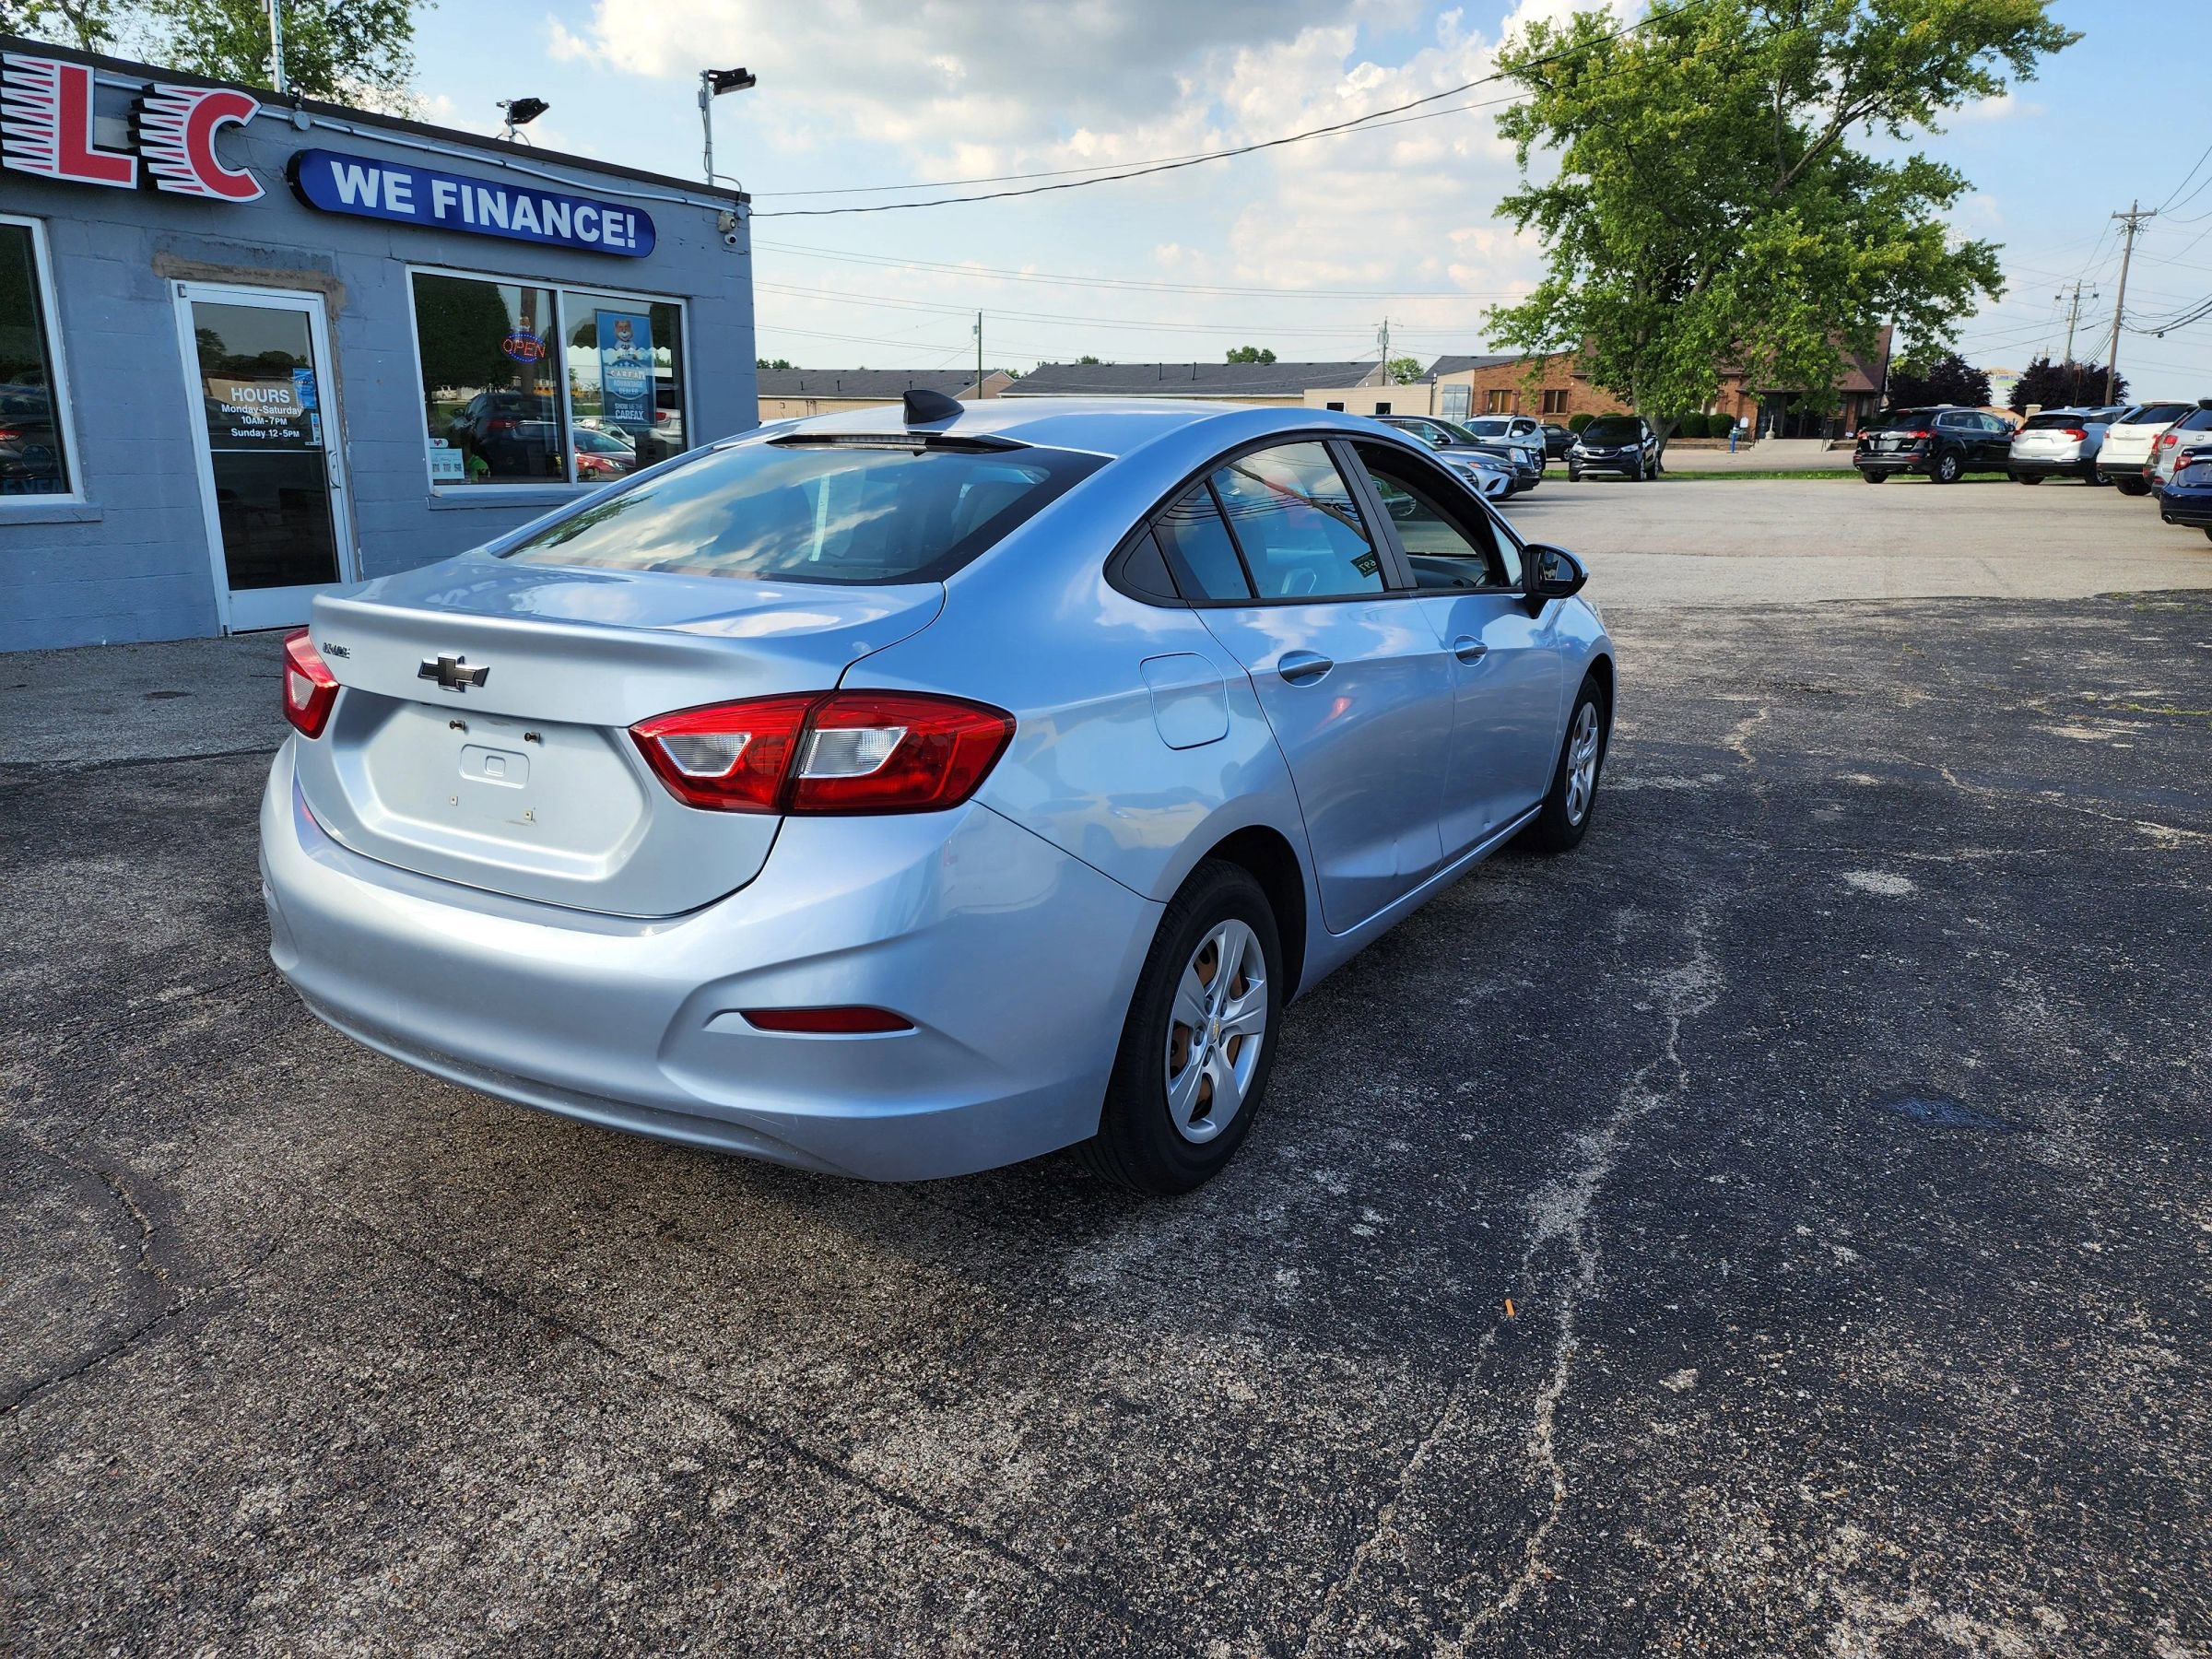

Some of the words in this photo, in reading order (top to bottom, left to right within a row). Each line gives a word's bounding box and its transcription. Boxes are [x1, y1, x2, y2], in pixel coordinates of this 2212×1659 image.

[330, 161, 416, 215] WE
[431, 180, 637, 249] FINANCE!
[502, 338, 546, 359] OPEN
[230, 387, 290, 404] HOURS
[221, 405, 302, 418] Monday-Saturday
[615, 409, 645, 420] CARFAX
[230, 429, 266, 439] Sunday
